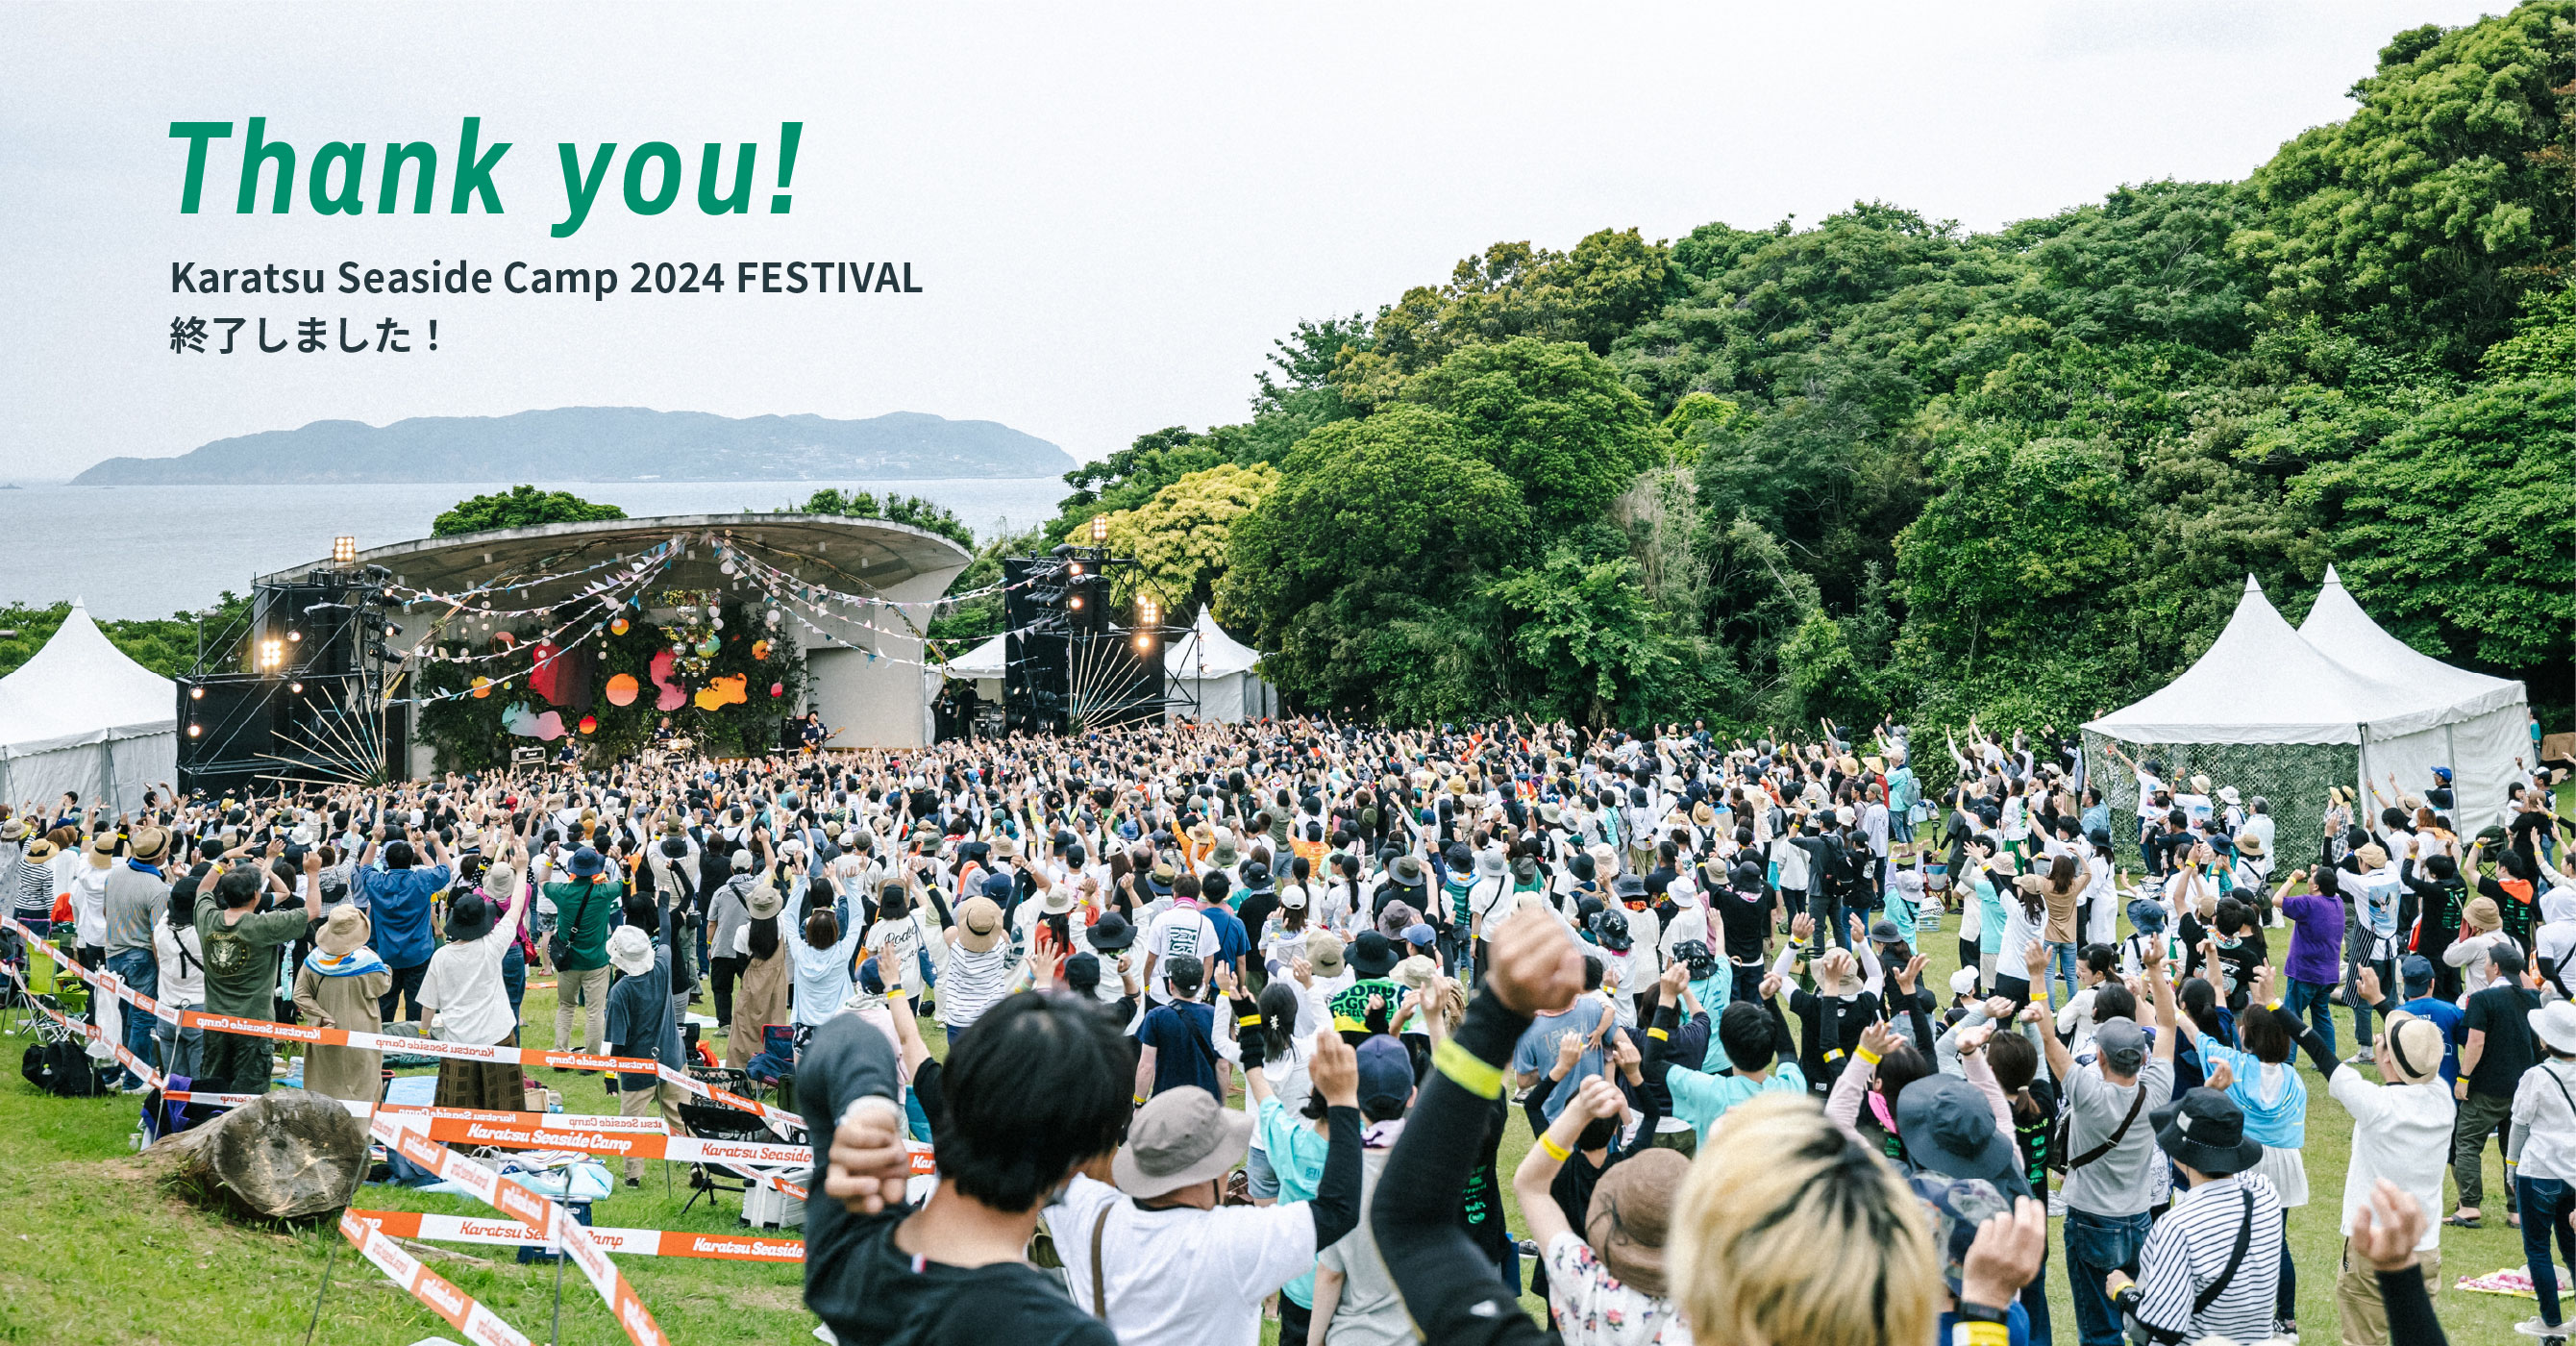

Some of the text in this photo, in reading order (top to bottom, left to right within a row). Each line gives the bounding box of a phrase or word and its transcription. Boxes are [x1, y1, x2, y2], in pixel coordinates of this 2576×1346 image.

[467, 1123, 632, 1155] Karatsu Seaside Camp
[702, 1142, 812, 1162] Karatsu Seaside
[459, 1220, 522, 1238] Karatsu
[693, 1237, 805, 1258] Karatsu Seaside
